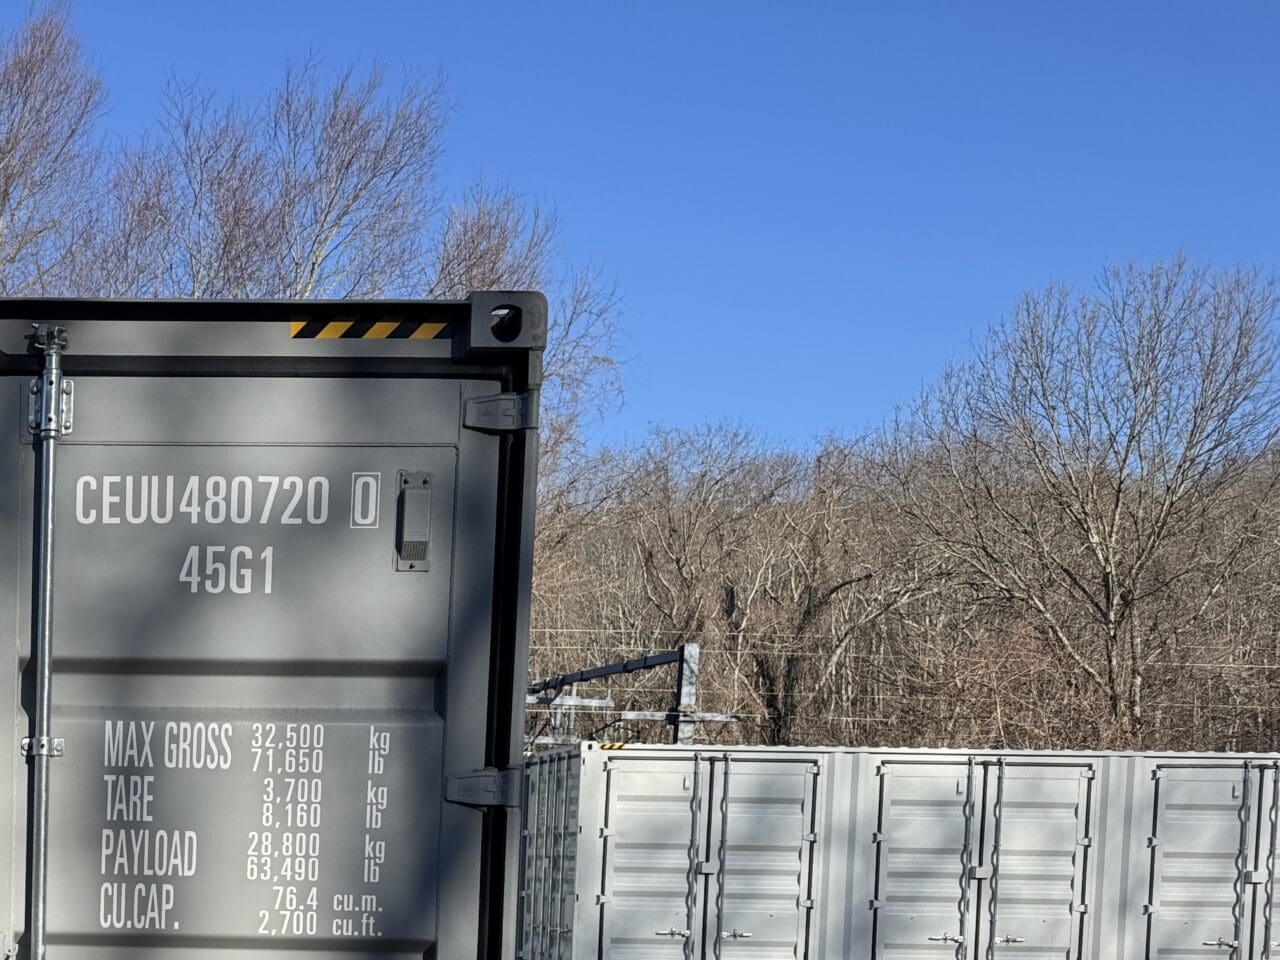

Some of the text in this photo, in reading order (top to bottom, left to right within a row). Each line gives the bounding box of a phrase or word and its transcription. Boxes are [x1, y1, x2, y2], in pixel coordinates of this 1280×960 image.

[353, 475, 377, 526] 0
[179, 545, 274, 594] 45G1
[103, 720, 391, 770] MAX GROSS 32,500 kg
[251, 748, 384, 775] 71,650 lb
[103, 774, 388, 822] TARE 3,700 kg
[262, 803, 382, 829] 8,160 lb
[100, 828, 386, 877] PAYLOAD 28,800 kg
[246, 857, 380, 883] 63,490 lb
[100, 882, 383, 930] CU.CAP. 76.4 cu.m.
[258, 910, 383, 937] 2,700 cu.ft.
